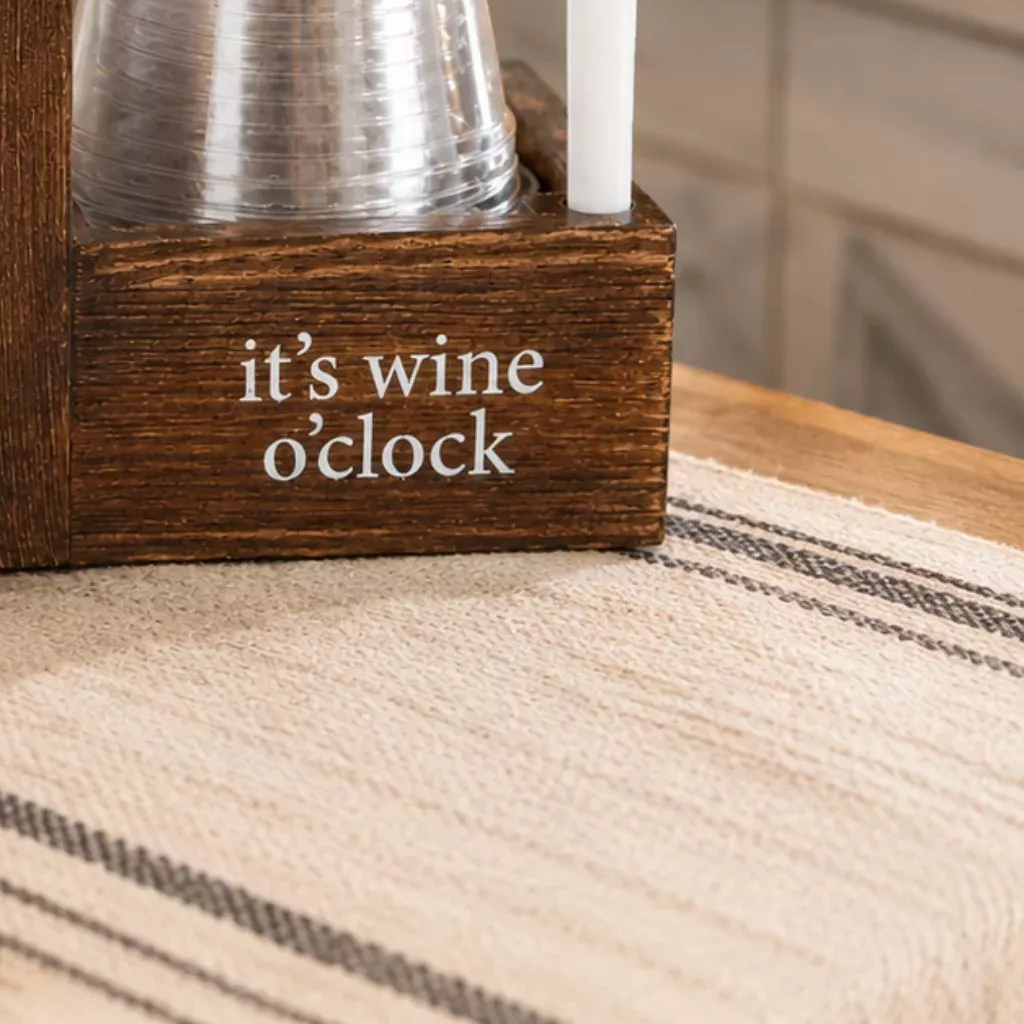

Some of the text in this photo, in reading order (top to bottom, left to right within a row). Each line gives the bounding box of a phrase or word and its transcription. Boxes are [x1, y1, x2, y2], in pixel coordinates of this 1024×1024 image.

[239, 331, 544, 403] it’s wine
[263, 408, 515, 481] o’clock
